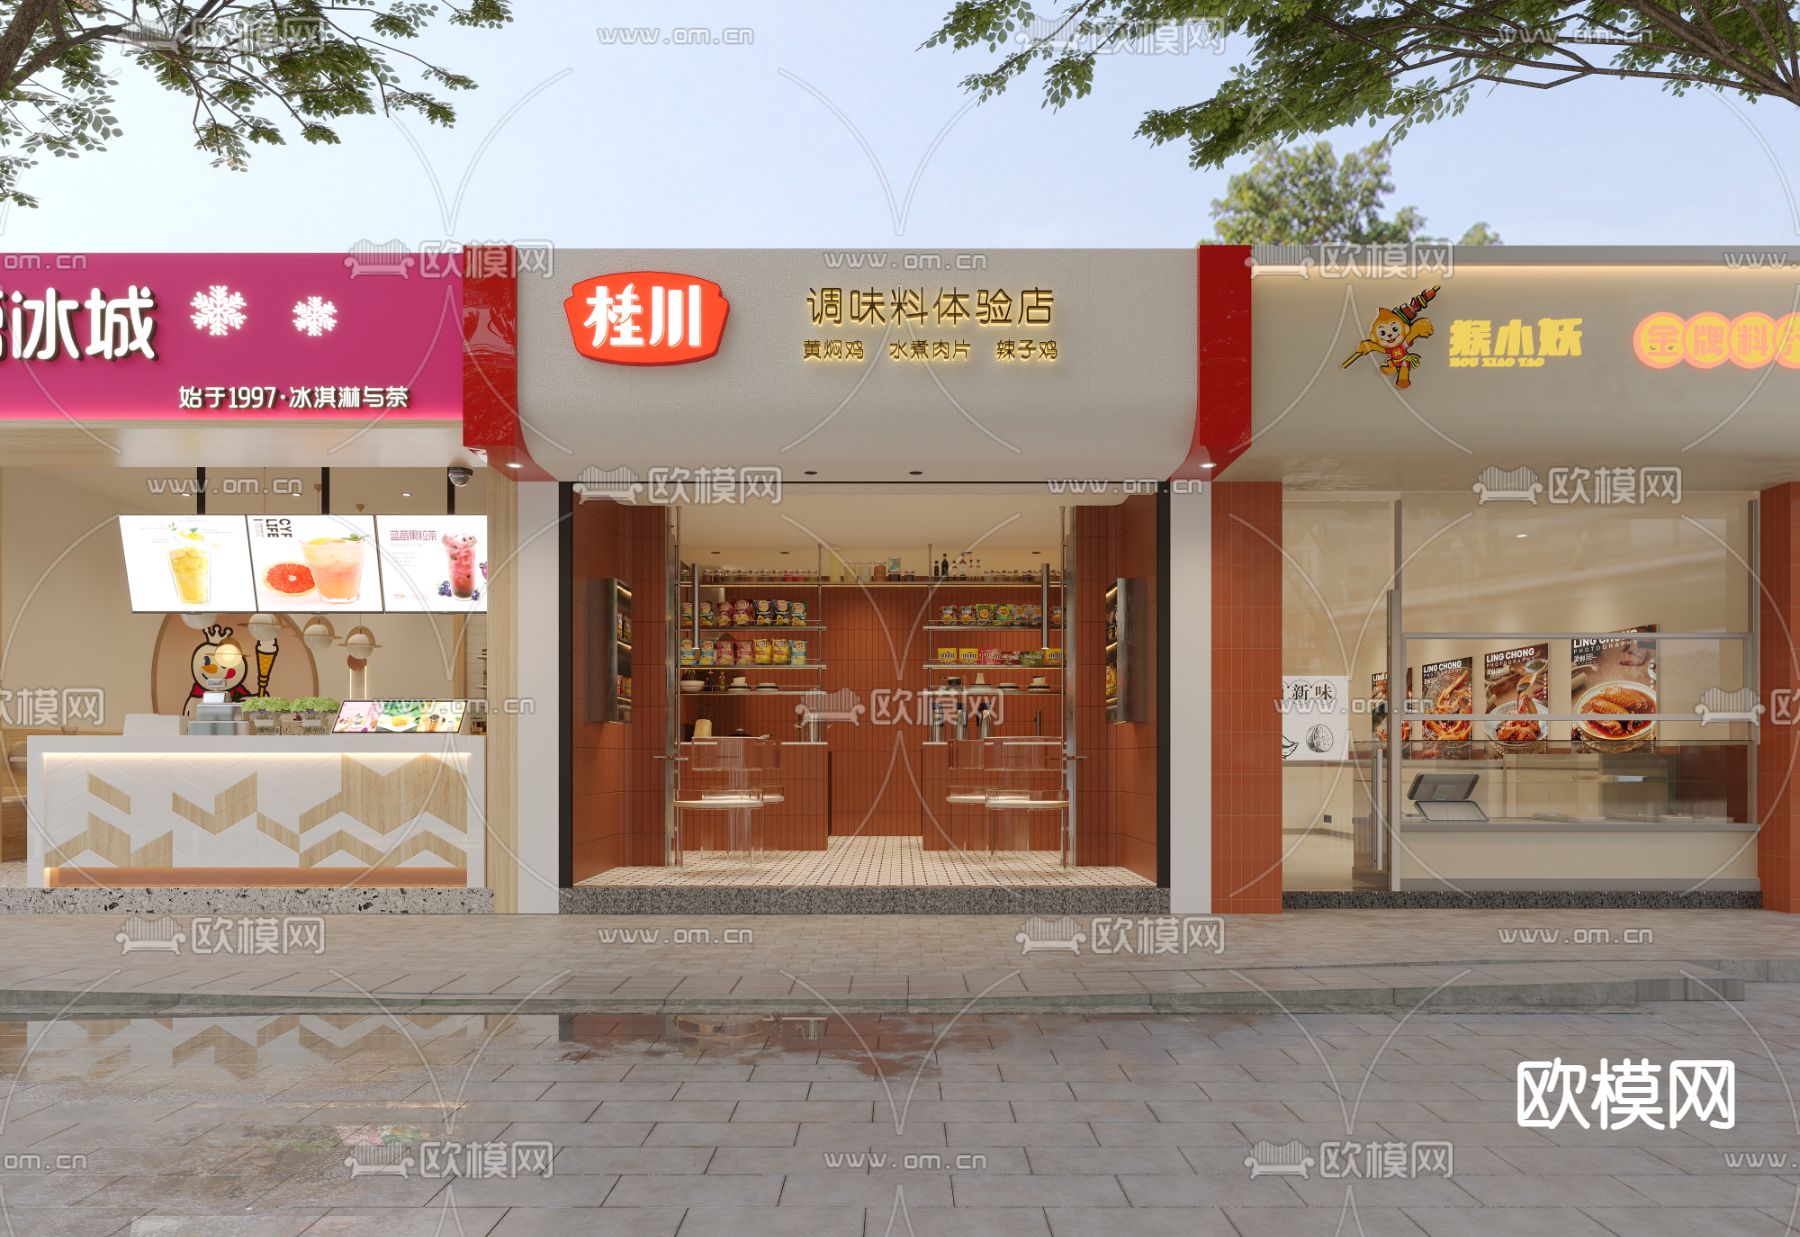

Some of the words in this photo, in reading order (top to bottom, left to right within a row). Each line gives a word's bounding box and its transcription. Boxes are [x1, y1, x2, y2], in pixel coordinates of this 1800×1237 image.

[583, 283, 704, 347] 桂川
[806, 286, 1055, 326] 调味料体验店
[0, 285, 156, 360] 冰城
[802, 338, 864, 360] 黄焖鸡
[889, 338, 971, 360] 水煮肉片
[996, 338, 1059, 360] 辣子鸡
[1438, 660, 1462, 671] CHONG
[1486, 650, 1505, 663] LING
[1505, 647, 1535, 660] CHONG
[1281, 684, 1333, 701] 新味
